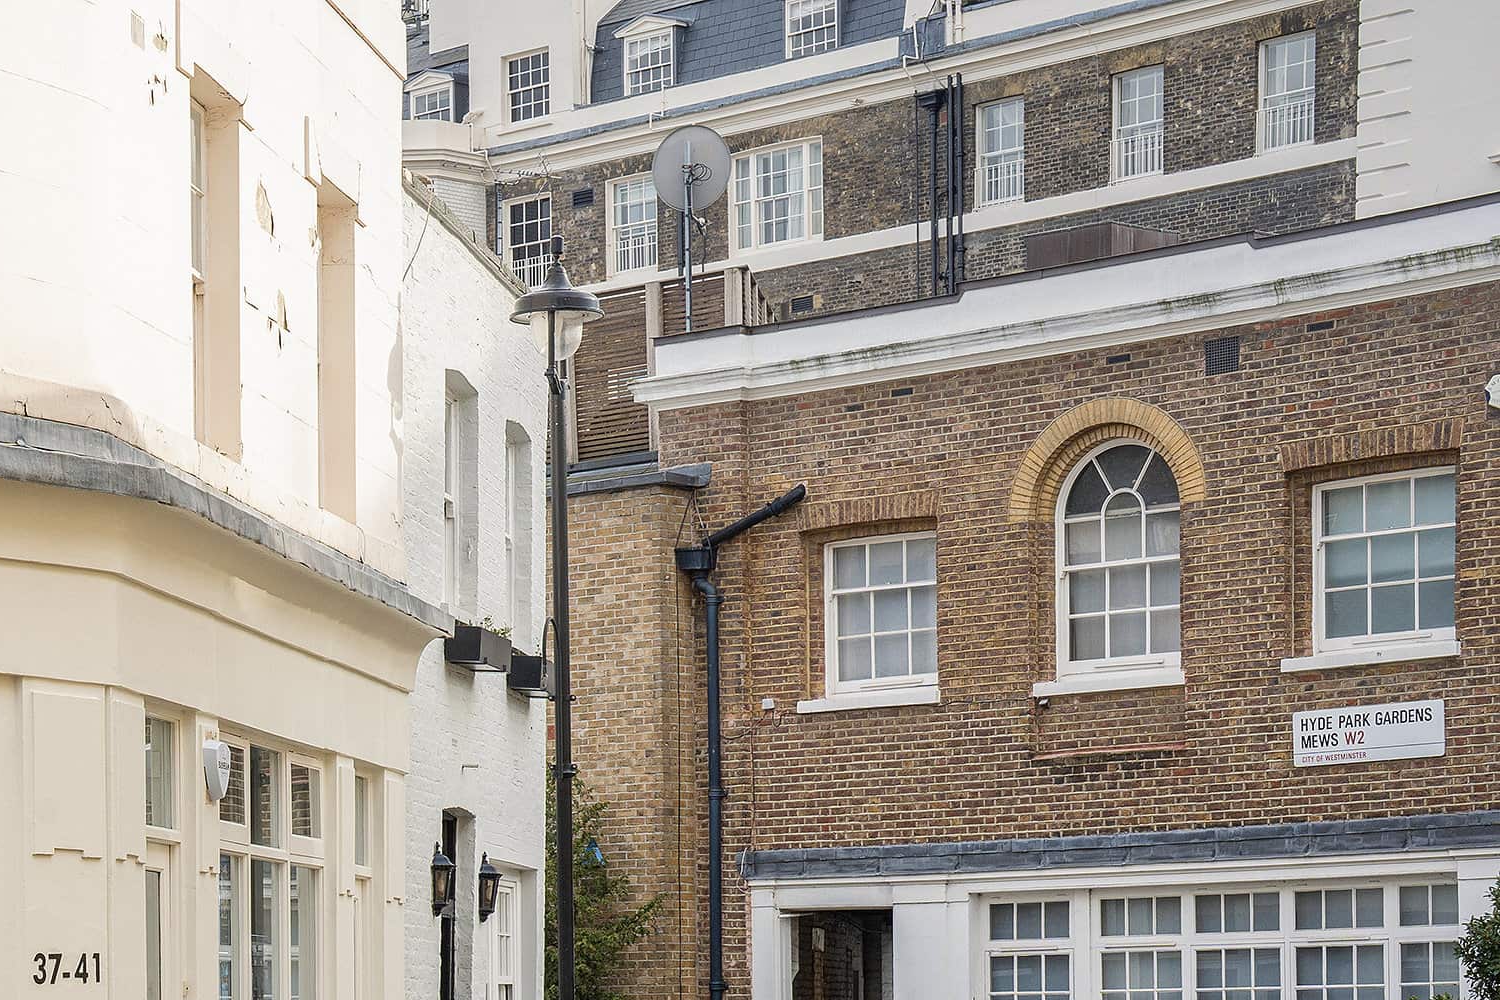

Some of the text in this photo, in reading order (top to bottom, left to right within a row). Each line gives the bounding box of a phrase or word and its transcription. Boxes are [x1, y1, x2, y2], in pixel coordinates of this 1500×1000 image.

[1300, 707, 1433, 732] HYDE PARK GARDENS
[1301, 730, 1365, 749] MEWS W2
[1301, 751, 1367, 763] CITY OF WESTMINSTER
[33, 952, 100, 985] 37-41
